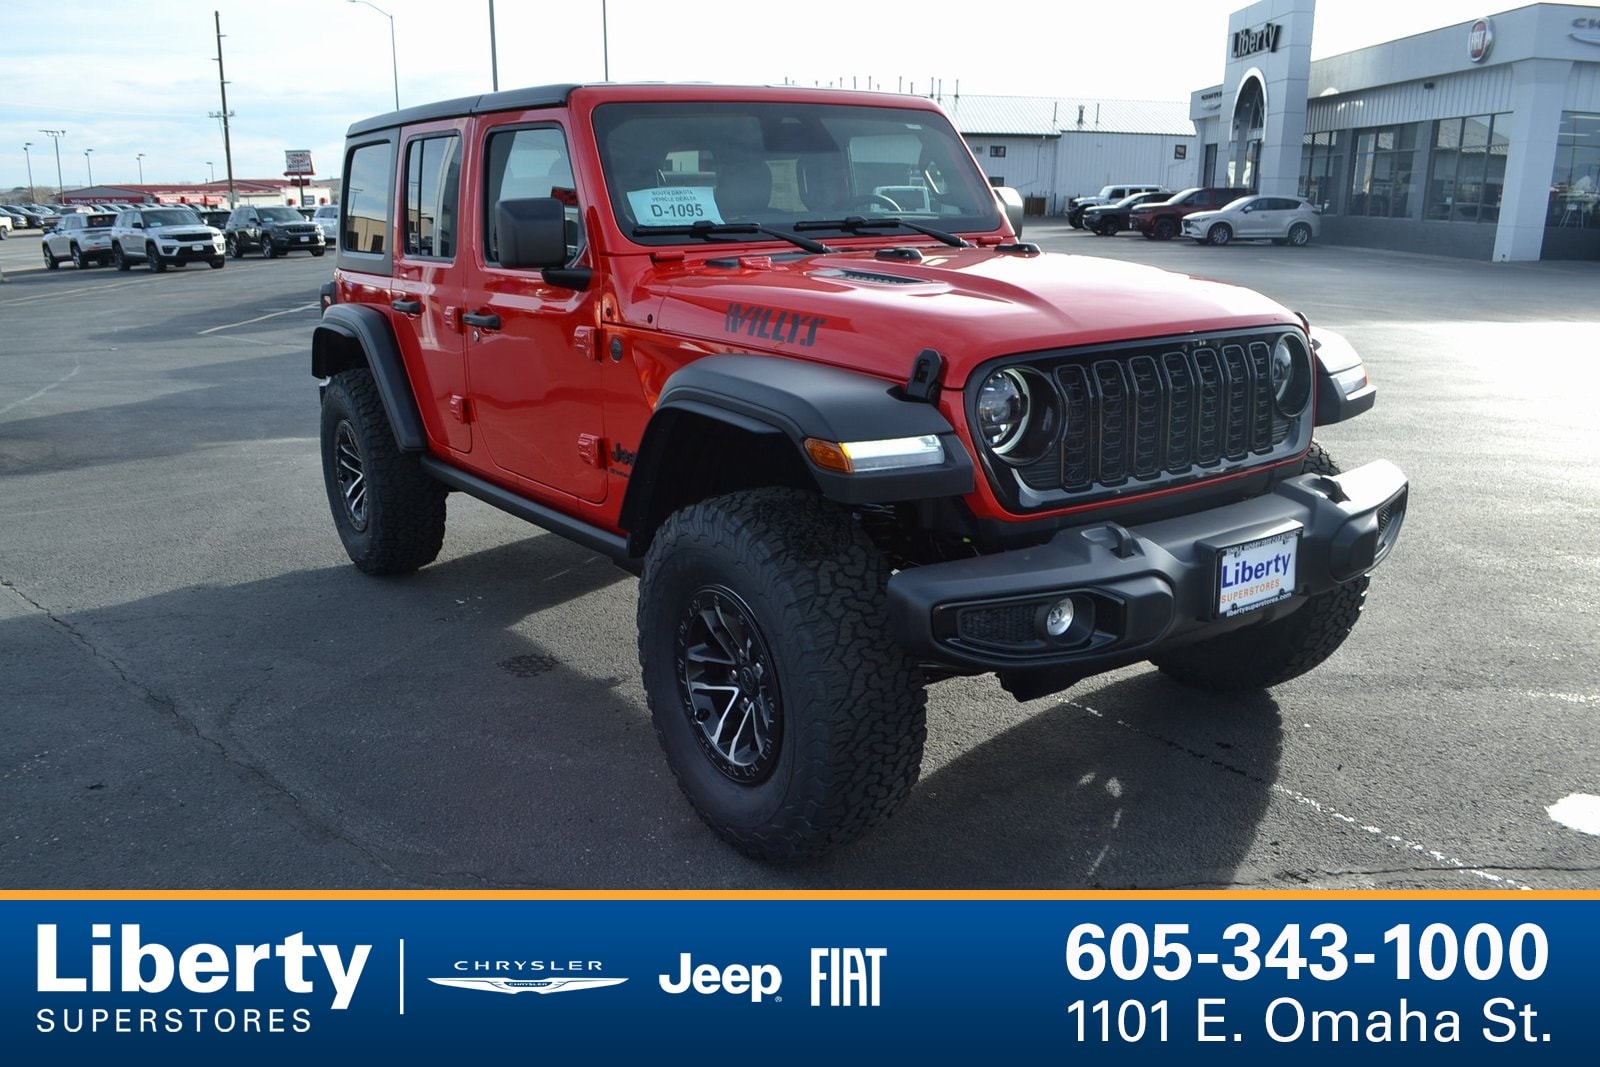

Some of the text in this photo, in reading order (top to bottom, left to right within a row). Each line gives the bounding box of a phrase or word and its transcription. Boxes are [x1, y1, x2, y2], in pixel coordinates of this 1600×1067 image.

[1231, 23, 1282, 58] Liberty
[651, 204, 703, 217] D-1095
[725, 303, 828, 347] WILLYS
[1222, 553, 1291, 588] Liberty
[1221, 579, 1280, 604] SUPERSTORES
